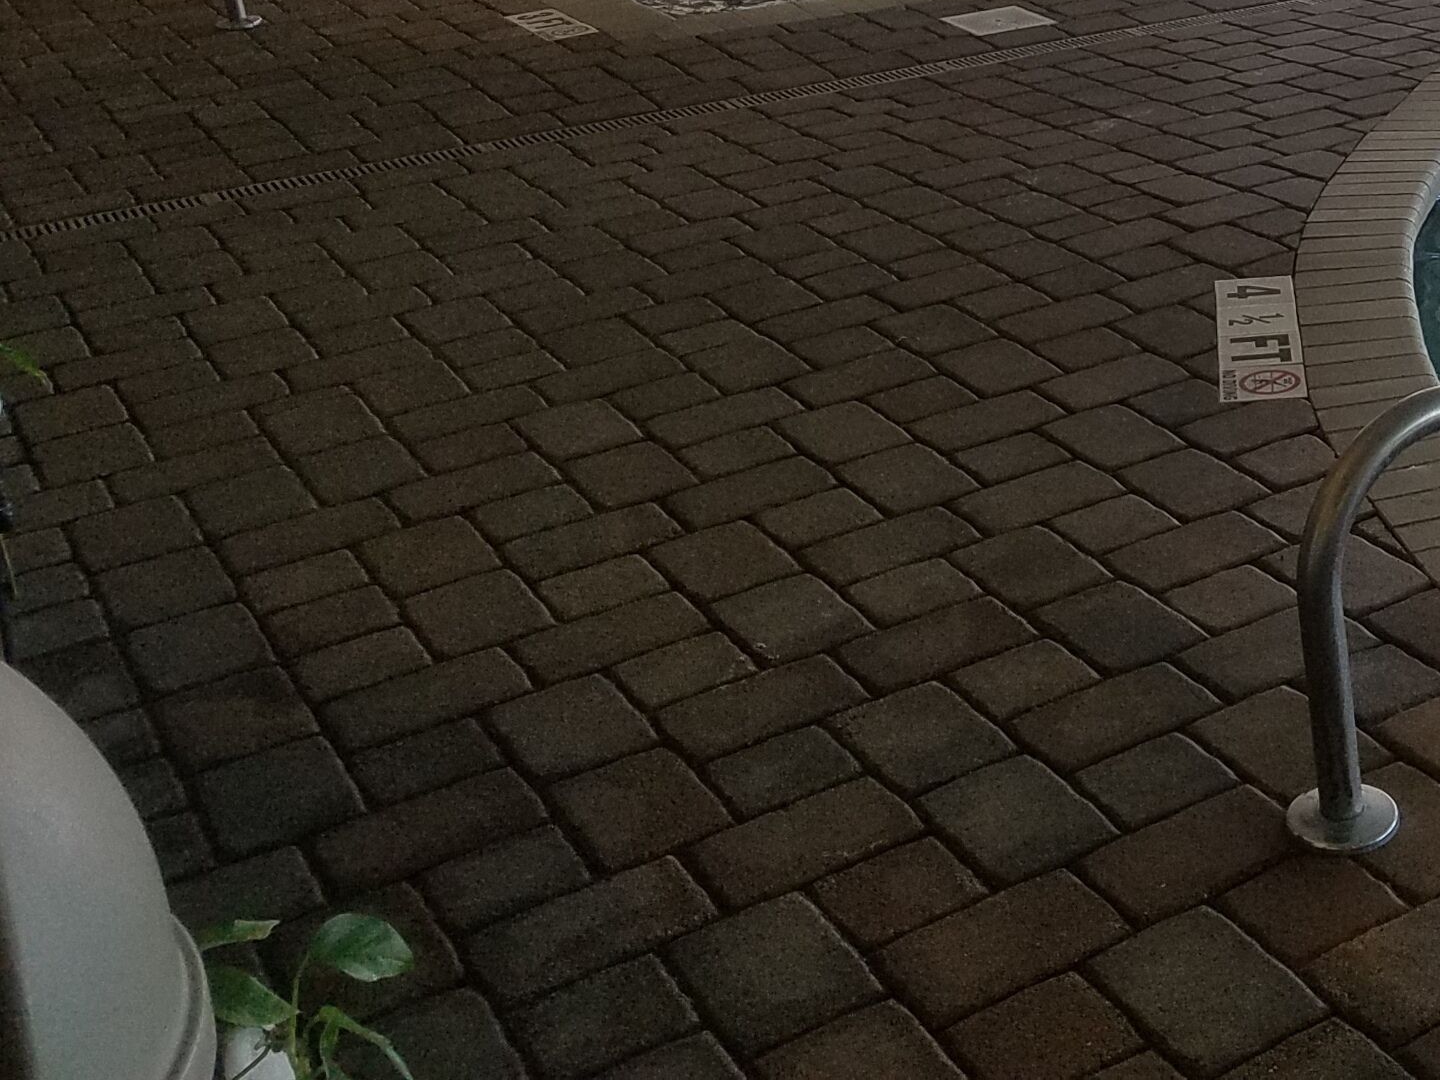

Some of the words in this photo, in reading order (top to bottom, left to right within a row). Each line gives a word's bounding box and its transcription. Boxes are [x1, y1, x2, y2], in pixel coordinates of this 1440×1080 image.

[526, 17, 574, 30] FT
[1227, 285, 1281, 299] 4
[1229, 333, 1292, 362] FT
